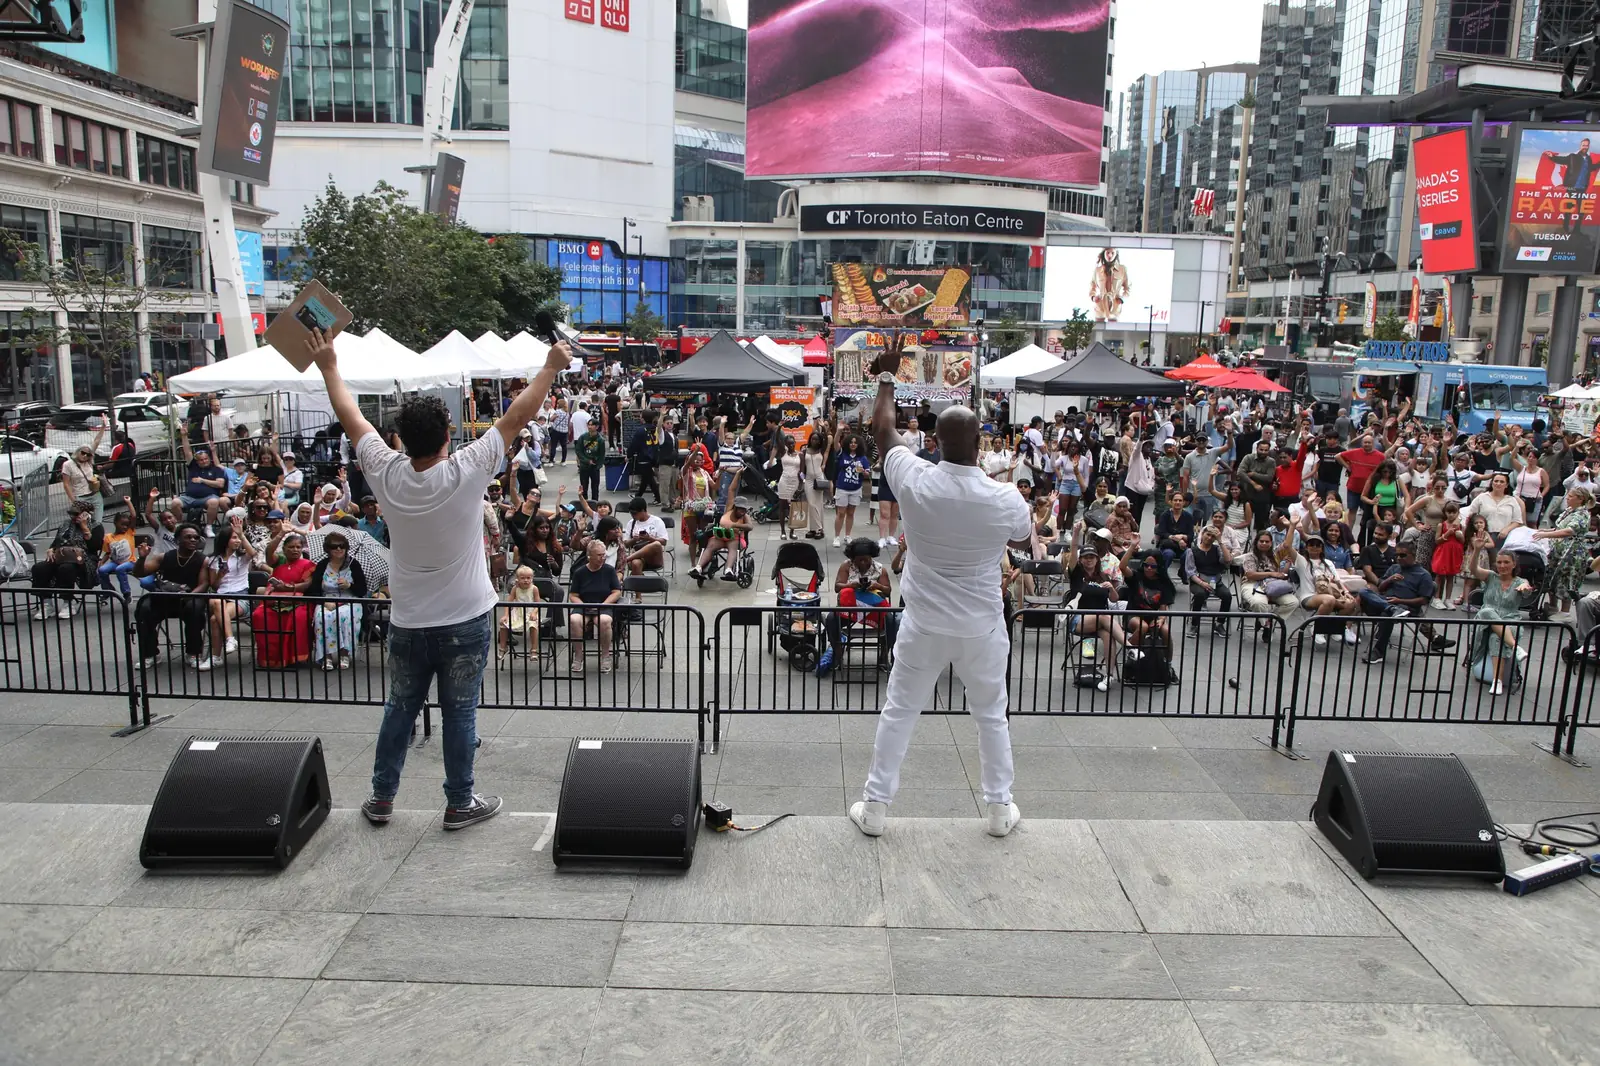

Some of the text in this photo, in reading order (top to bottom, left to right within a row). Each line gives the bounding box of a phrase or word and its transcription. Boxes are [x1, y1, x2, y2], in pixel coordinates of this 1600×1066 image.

[604, 10, 626, 26] QLO
[1416, 169, 1460, 190] ANADA'S
[1422, 189, 1458, 208] SERIES
[1546, 192, 1597, 200] AMAZING
[1518, 197, 1596, 214] RACE
[826, 210, 1024, 230] CF Toronto Eaton Centre
[1516, 212, 1592, 220] CANADA
[558, 244, 585, 254] BMO
[564, 262, 600, 273] Celebrate
[602, 263, 616, 274] the
[598, 276, 615, 286] with
[1366, 340, 1449, 362] GREEK GYROS
